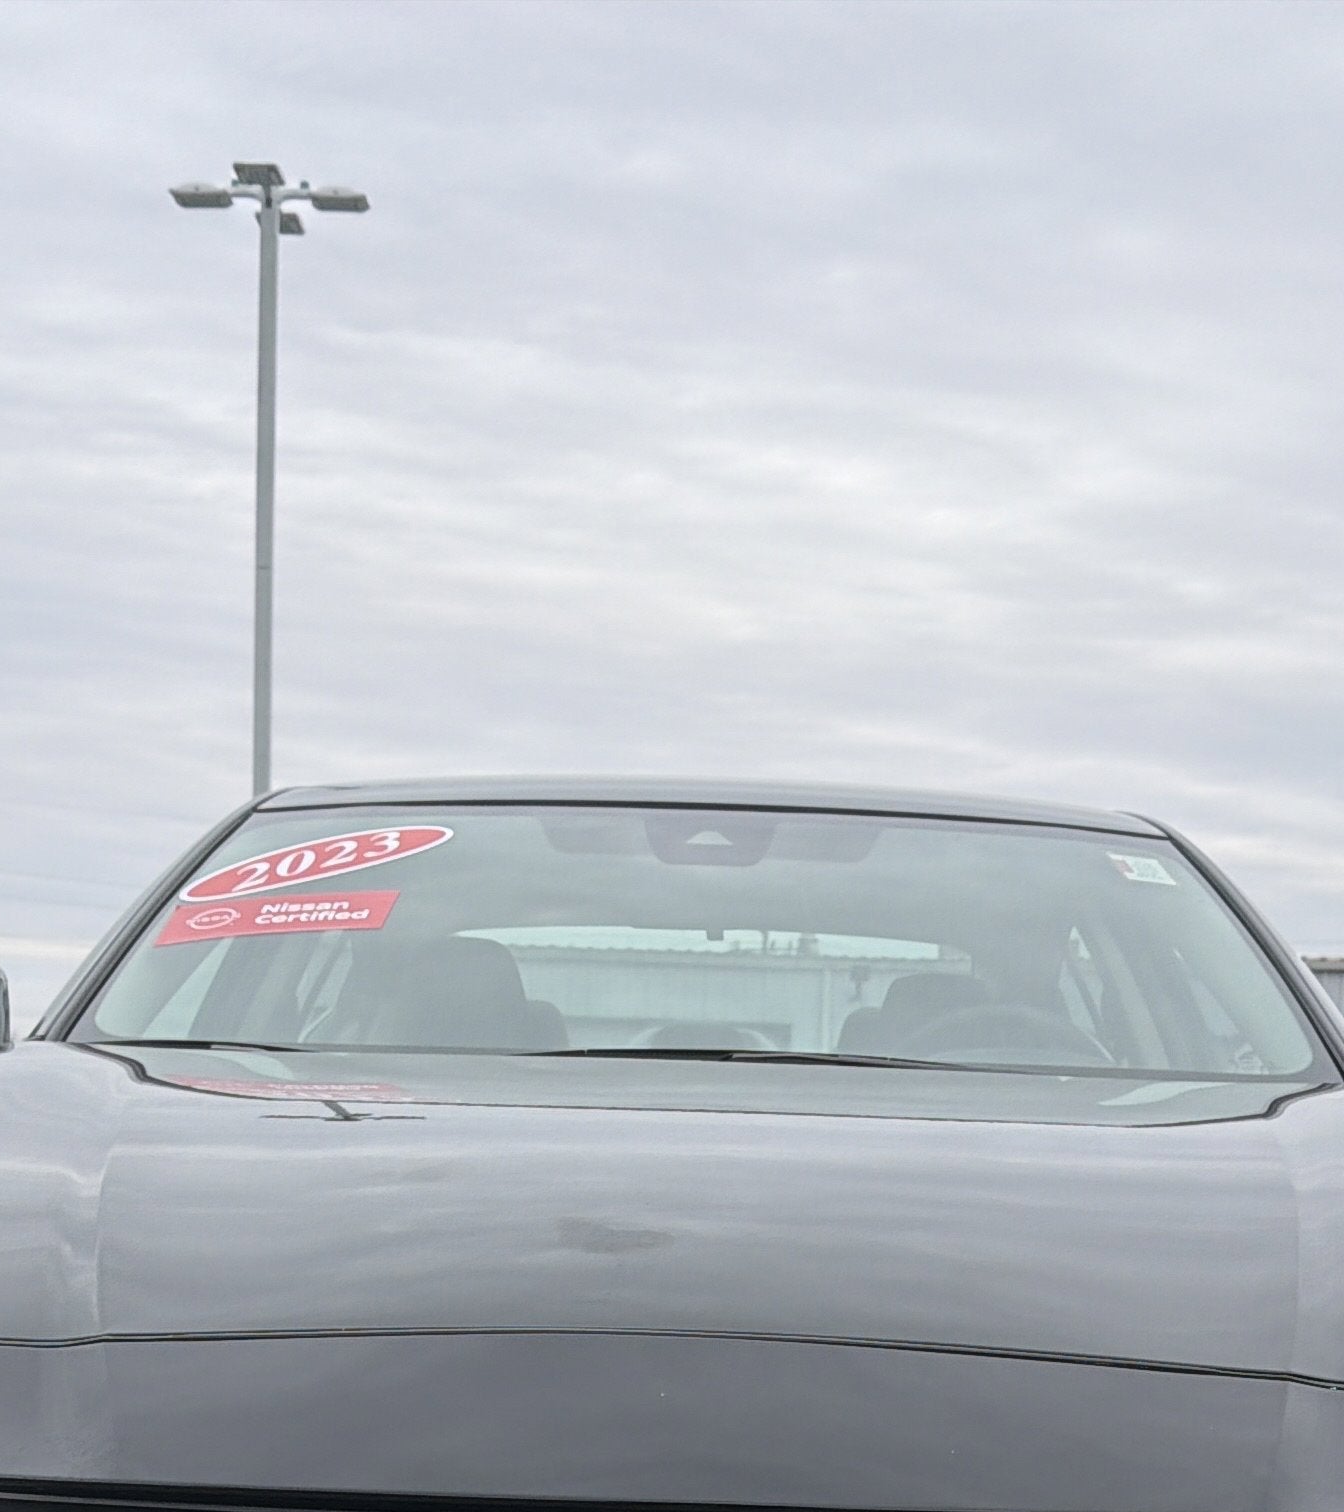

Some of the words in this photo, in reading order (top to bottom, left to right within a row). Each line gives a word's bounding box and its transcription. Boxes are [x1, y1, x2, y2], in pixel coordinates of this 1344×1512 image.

[232, 832, 400, 892] 2023
[260, 901, 350, 914] Nissan
[254, 909, 370, 925] Certified
